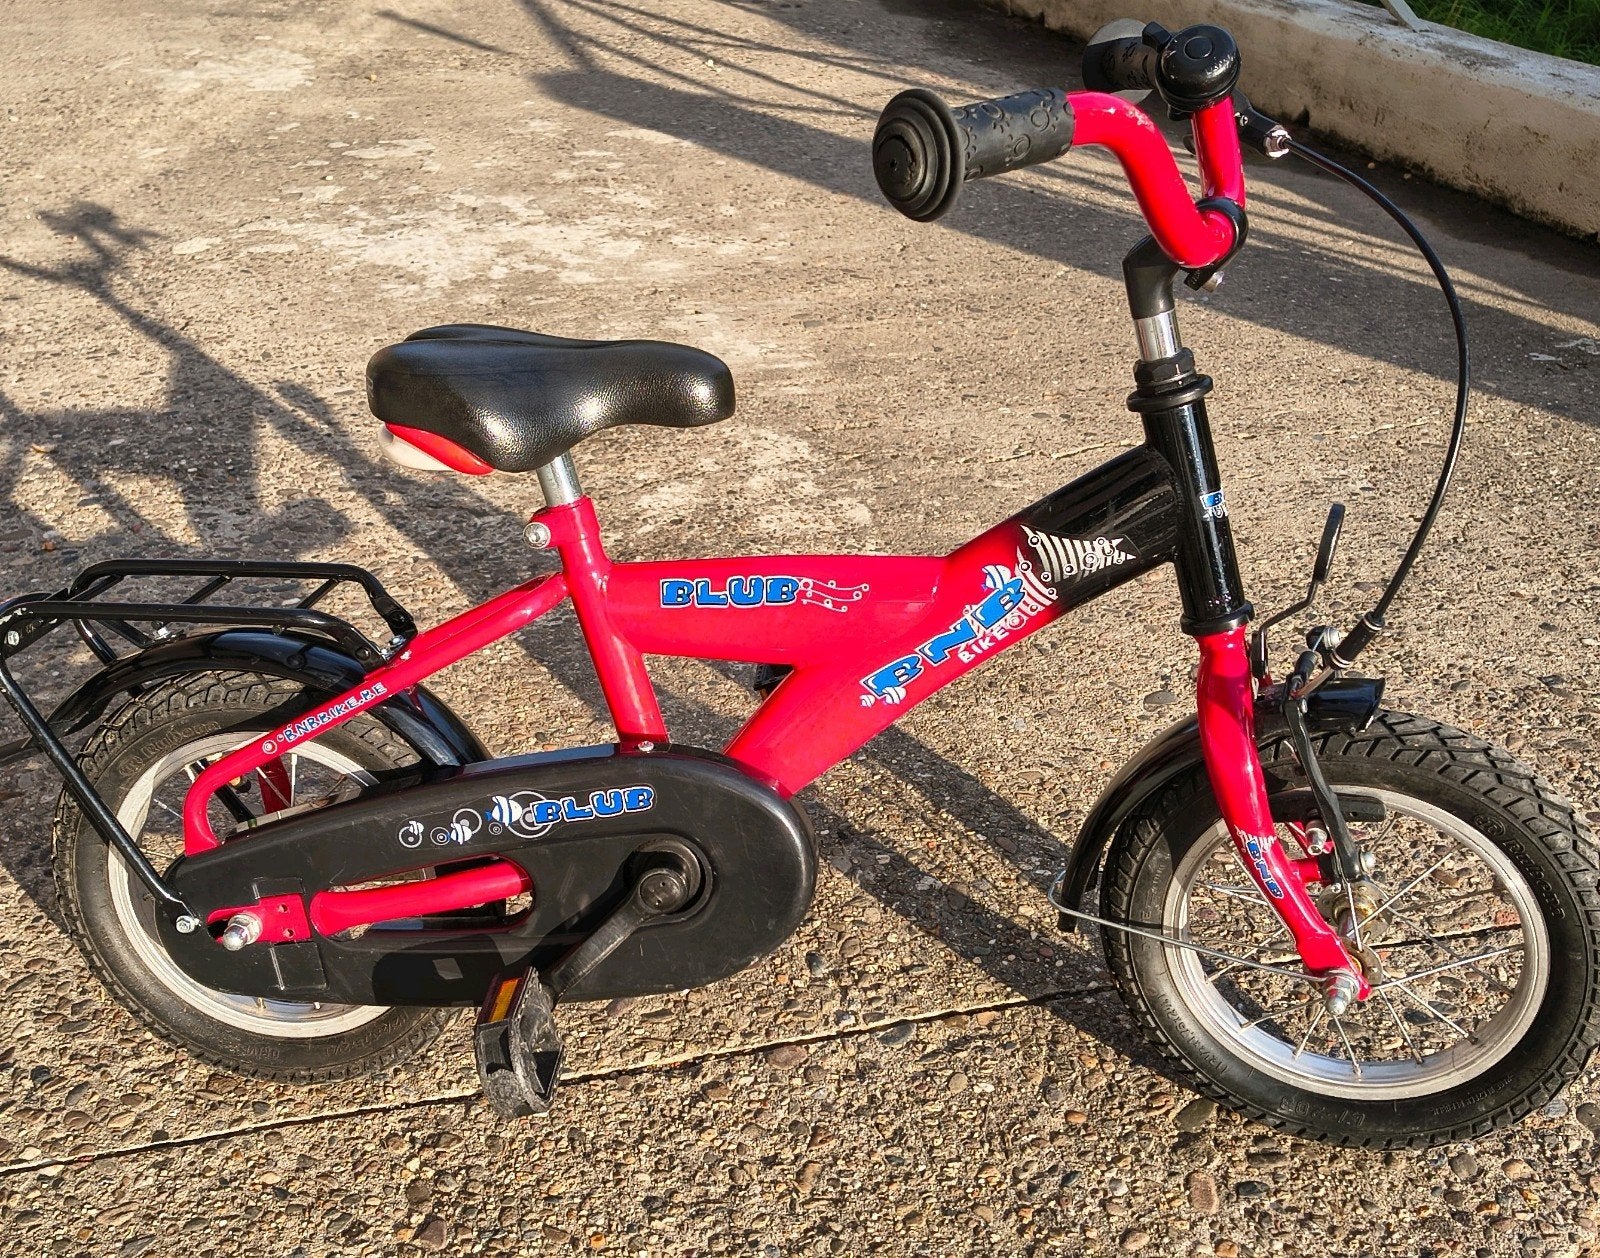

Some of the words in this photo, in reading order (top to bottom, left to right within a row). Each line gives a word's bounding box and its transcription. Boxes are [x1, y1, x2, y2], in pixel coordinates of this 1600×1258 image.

[660, 575, 800, 609] BLUB
[859, 576, 1026, 697] BNB
[957, 624, 1009, 664] BIKE
[283, 682, 387, 742] BNBBIKE.BE
[530, 786, 654, 824] BLUB
[1246, 838, 1284, 899] BNB
